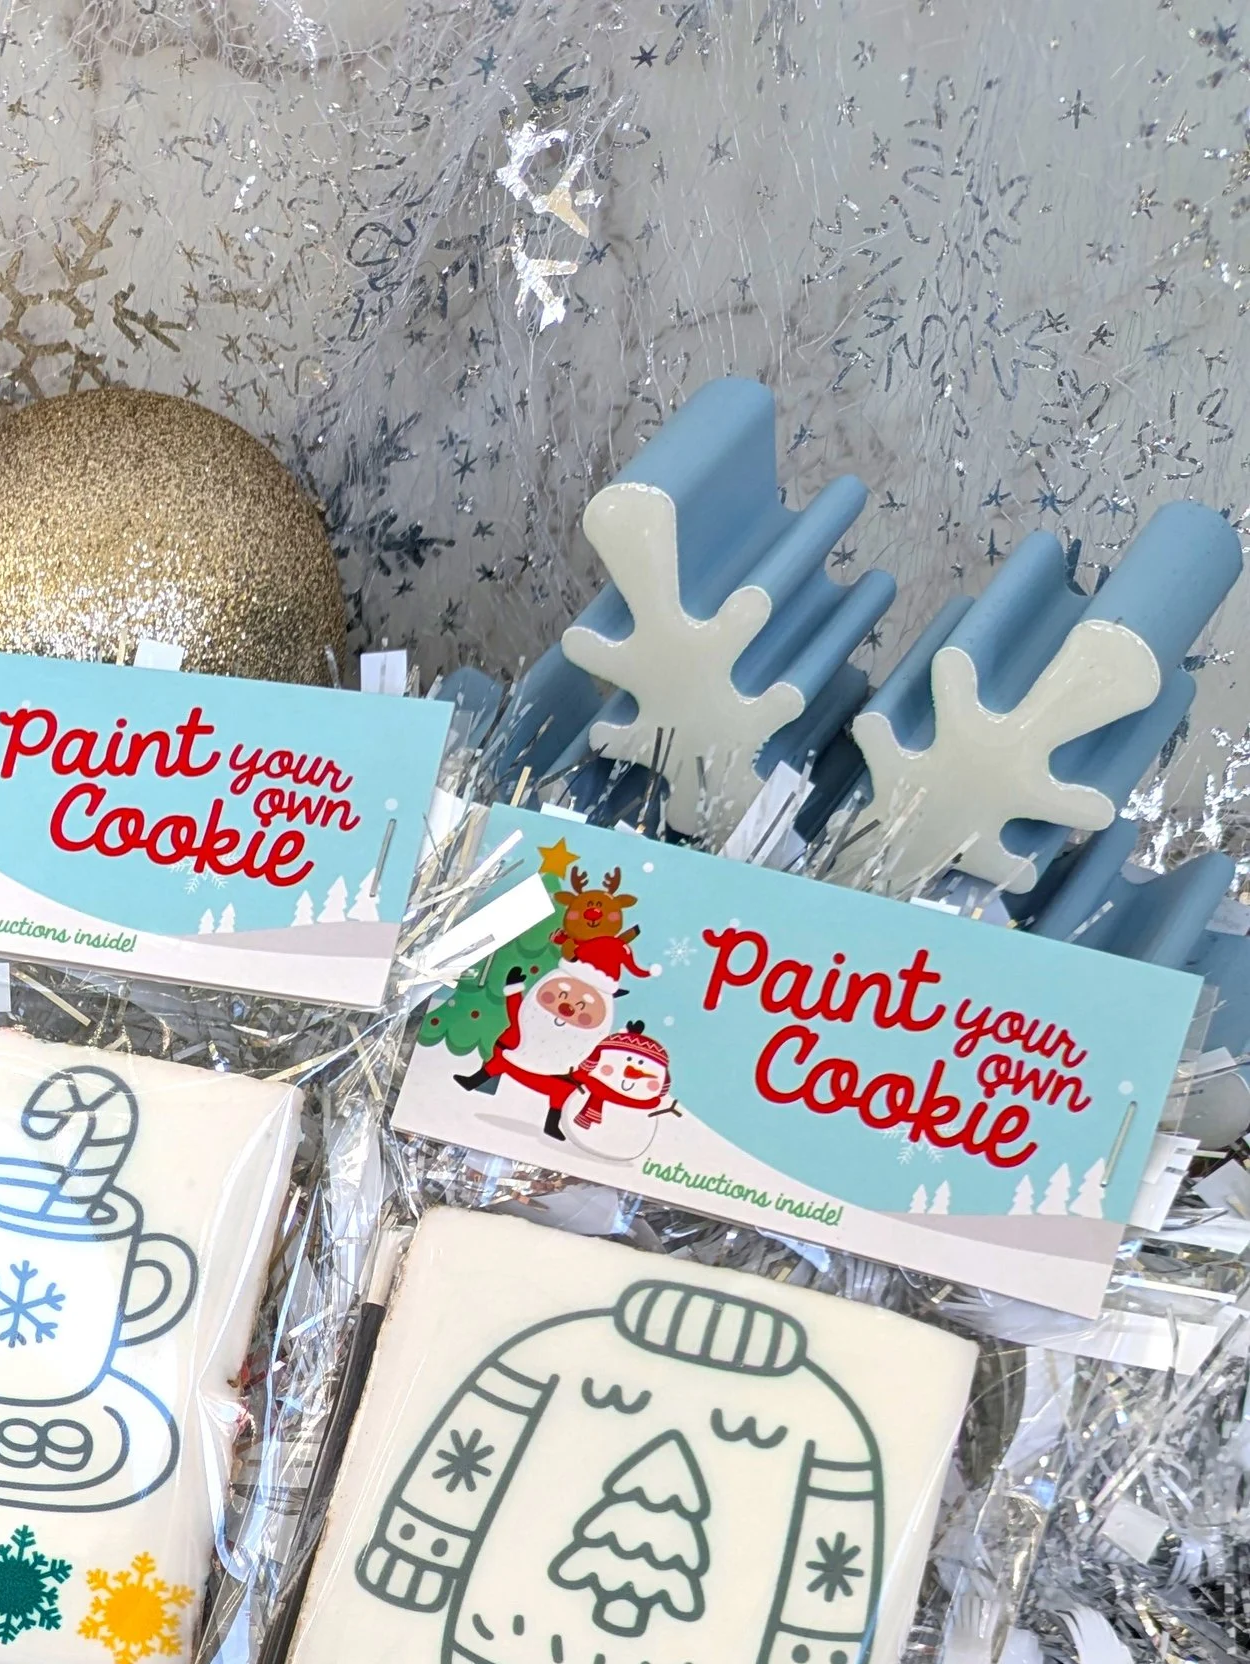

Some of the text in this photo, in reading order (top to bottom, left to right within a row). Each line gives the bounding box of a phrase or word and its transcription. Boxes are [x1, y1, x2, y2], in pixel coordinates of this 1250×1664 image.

[228, 741, 354, 796] your
[49, 781, 315, 888] Cookie
[252, 787, 361, 832] own
[73, 929, 138, 953] inside!
[702, 926, 1088, 1069] Paint your
[754, 1023, 1038, 1169] Cookie
[976, 1052, 1092, 1113] own
[642, 1157, 844, 1227] instructions inside!
